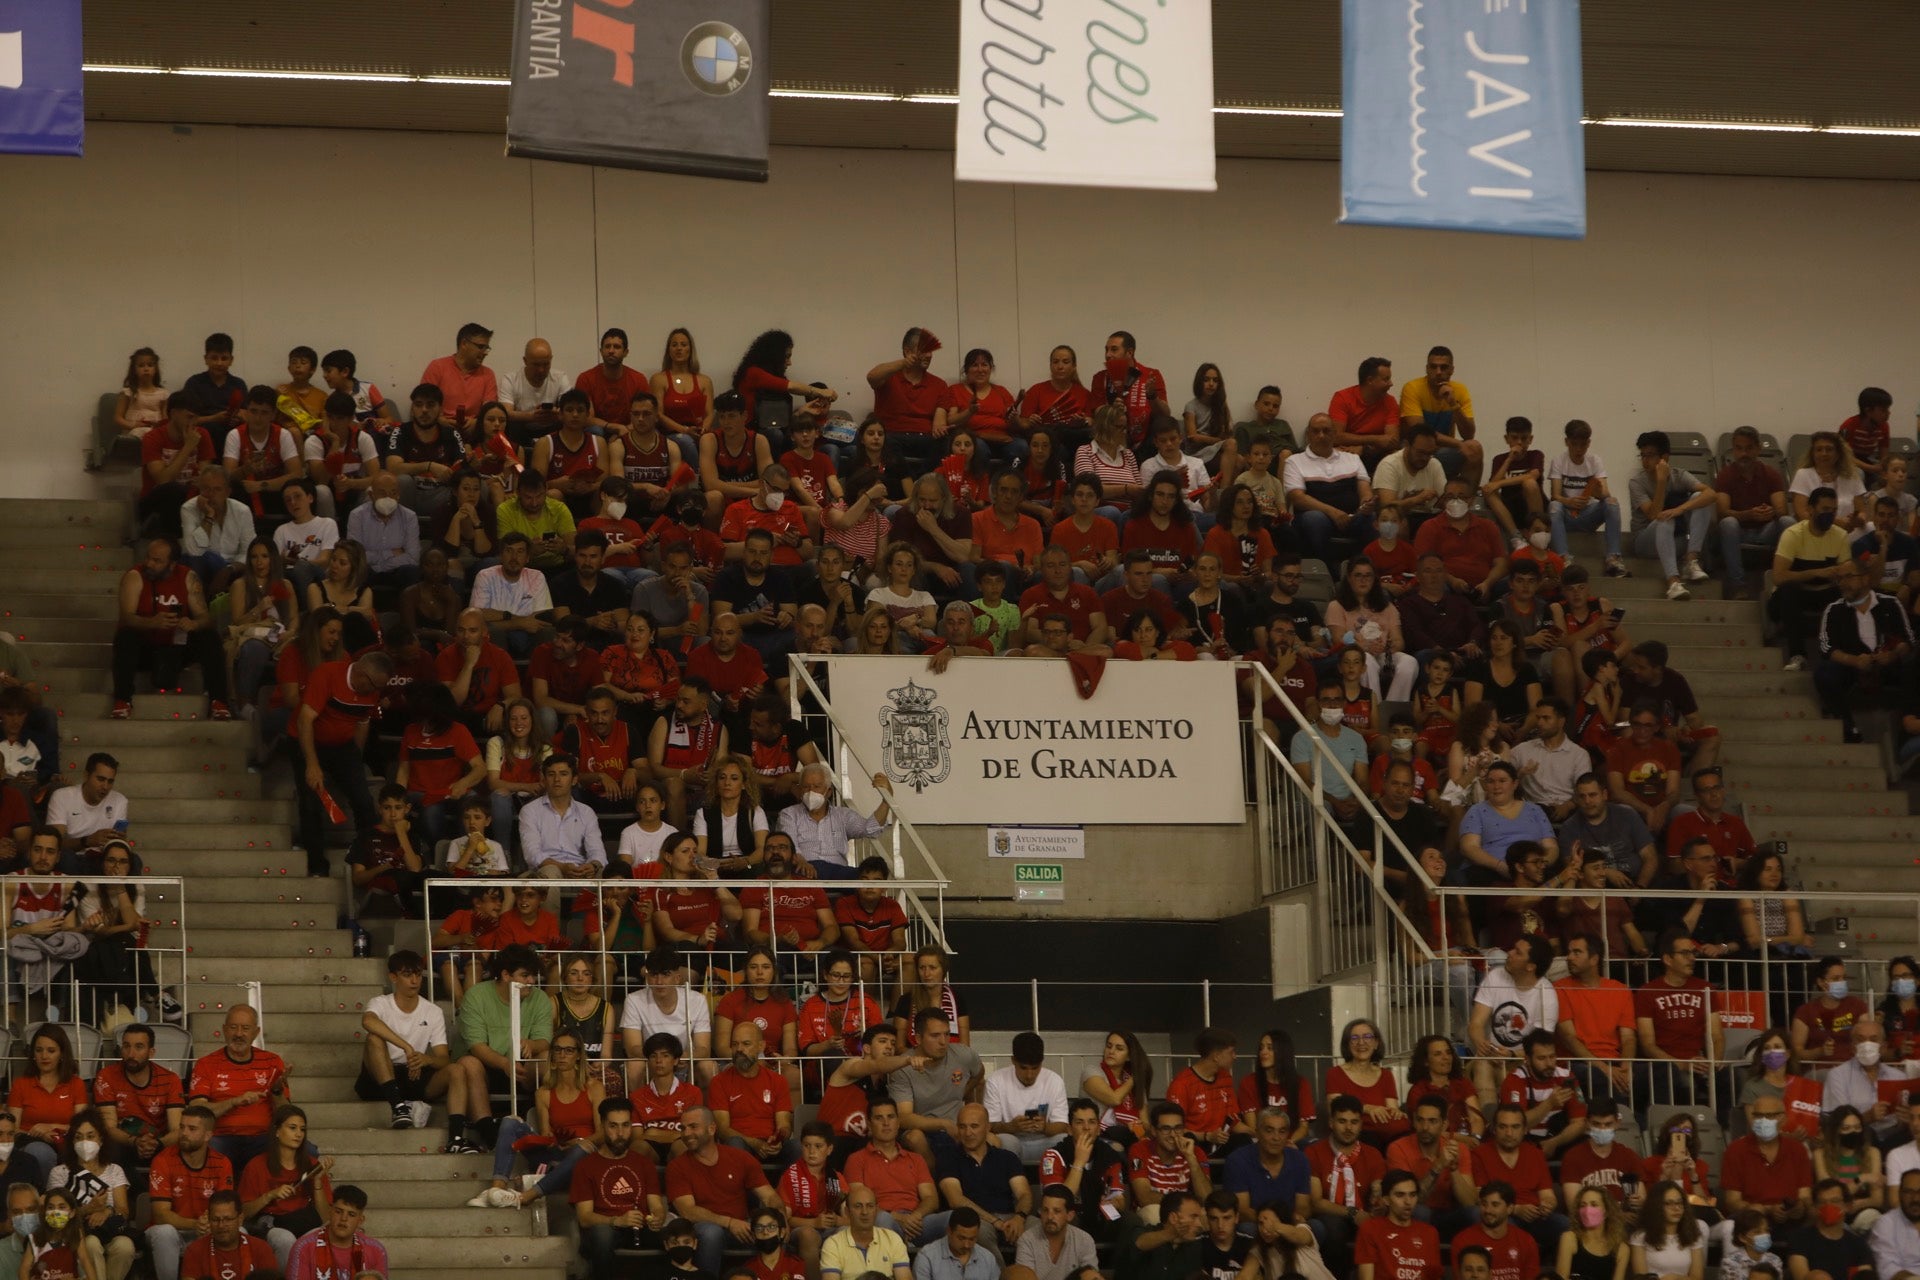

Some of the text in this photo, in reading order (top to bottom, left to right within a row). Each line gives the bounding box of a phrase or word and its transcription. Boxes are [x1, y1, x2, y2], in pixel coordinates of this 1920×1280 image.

[1777, 842, 1787, 854] 3
[1018, 867, 1060, 880] SALIDA
[1838, 919, 1847, 930] 2
[1656, 993, 1702, 1011] FITCH
